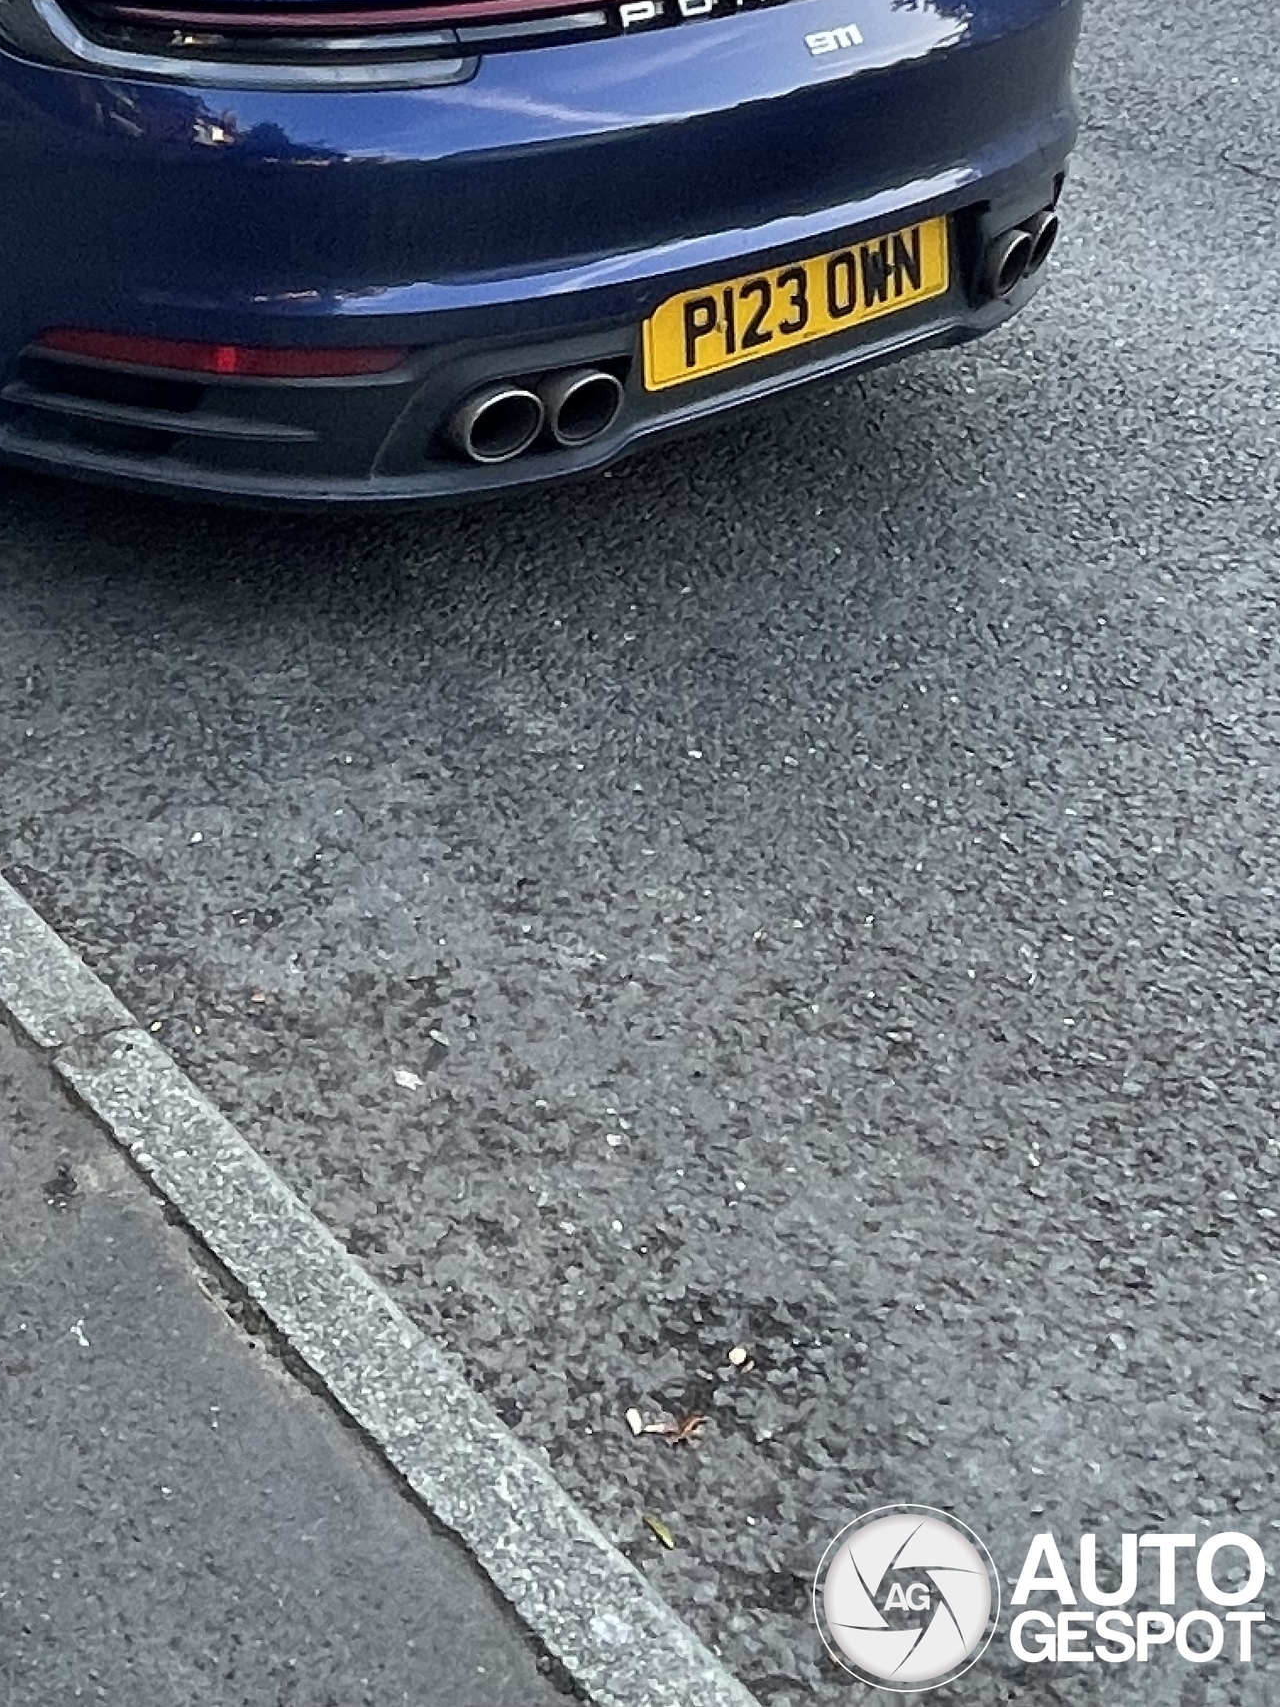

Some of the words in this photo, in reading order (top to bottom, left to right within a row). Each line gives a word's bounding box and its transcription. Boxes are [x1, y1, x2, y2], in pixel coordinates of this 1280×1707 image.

[804, 24, 865, 57] 911
[682, 266, 810, 369] P123
[826, 227, 922, 320] OWN
